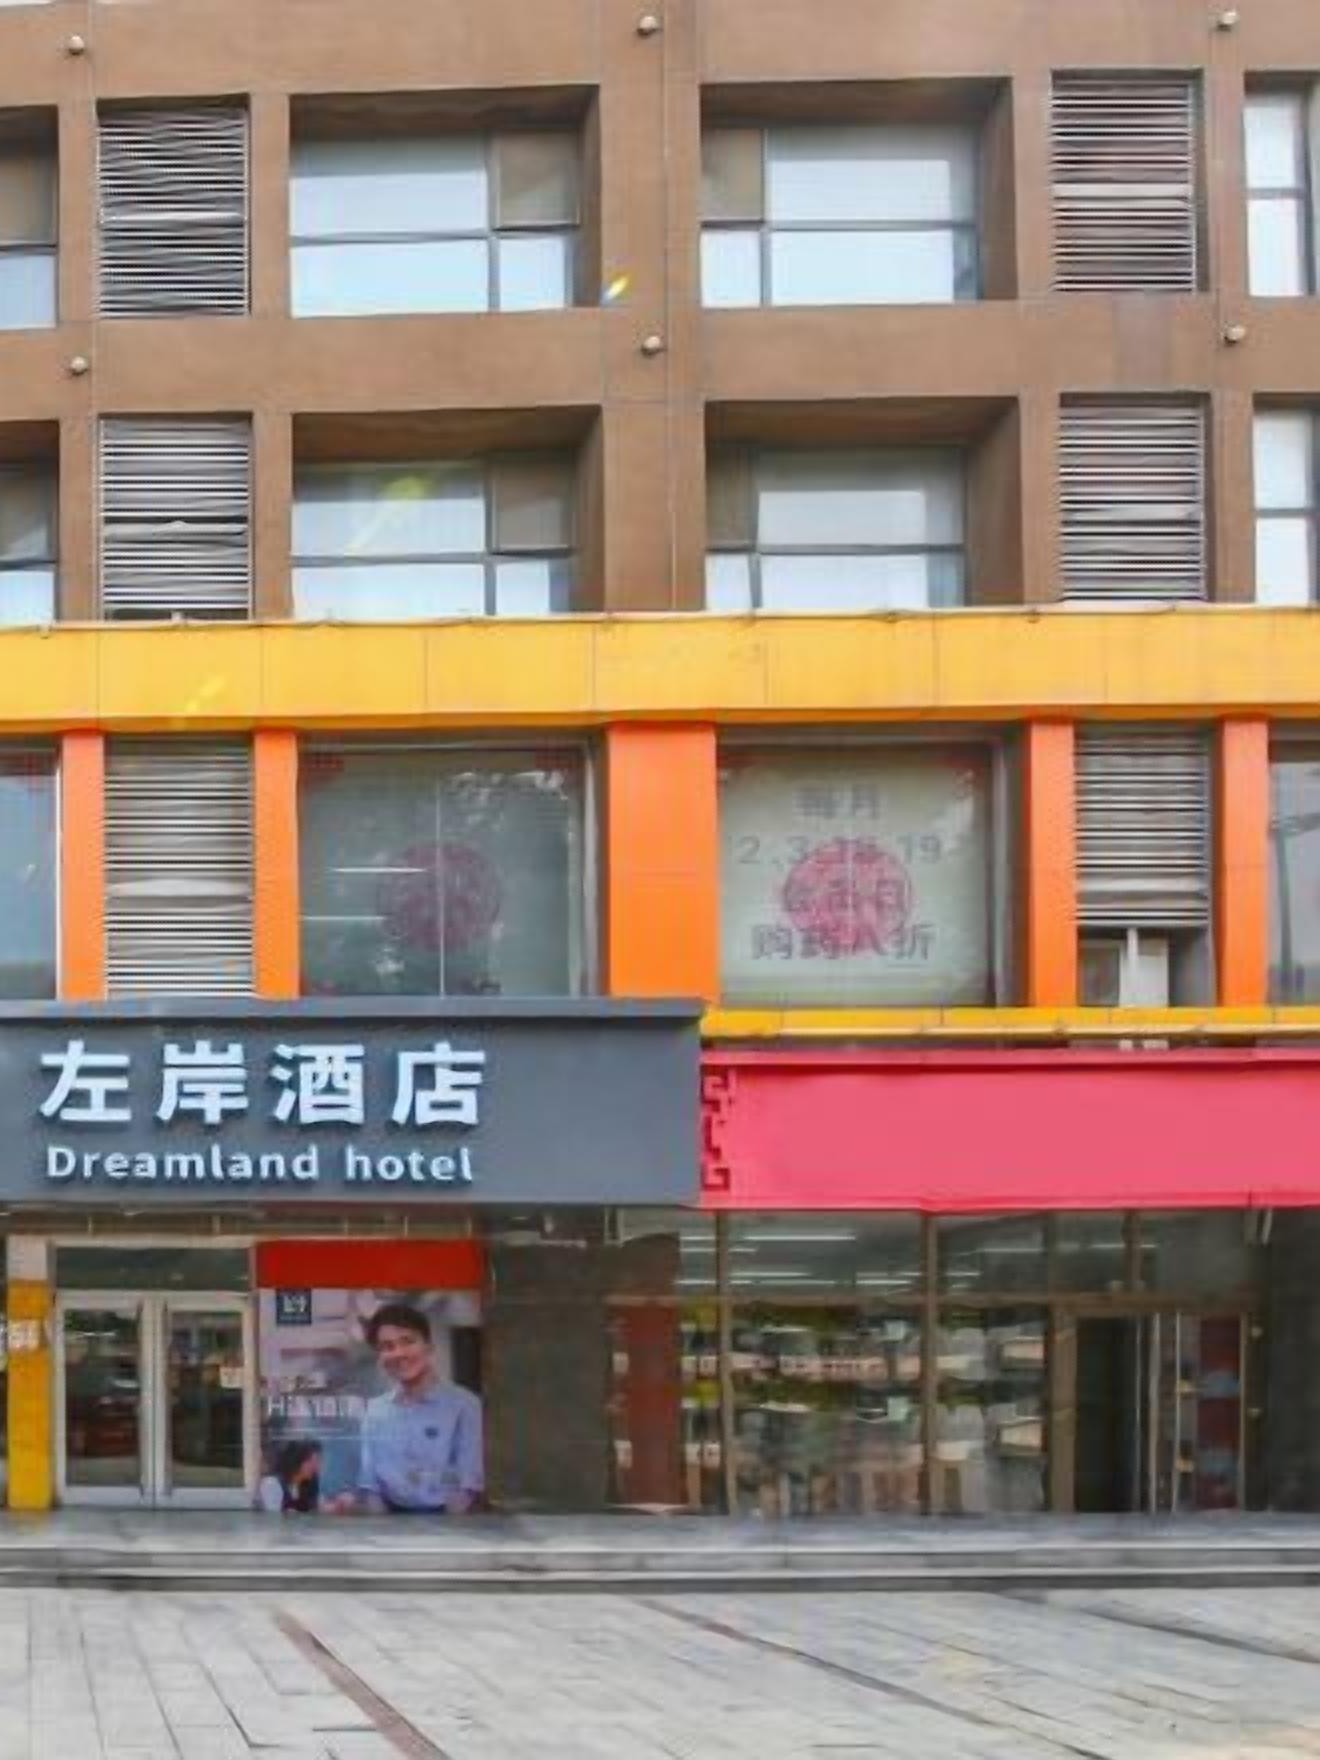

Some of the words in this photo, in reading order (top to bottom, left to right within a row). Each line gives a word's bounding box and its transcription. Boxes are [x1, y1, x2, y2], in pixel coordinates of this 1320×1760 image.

[39, 1040, 486, 1126] 左岸酒店
[46, 1144, 319, 1180] Dreamland
[344, 1146, 474, 1182] hotel
